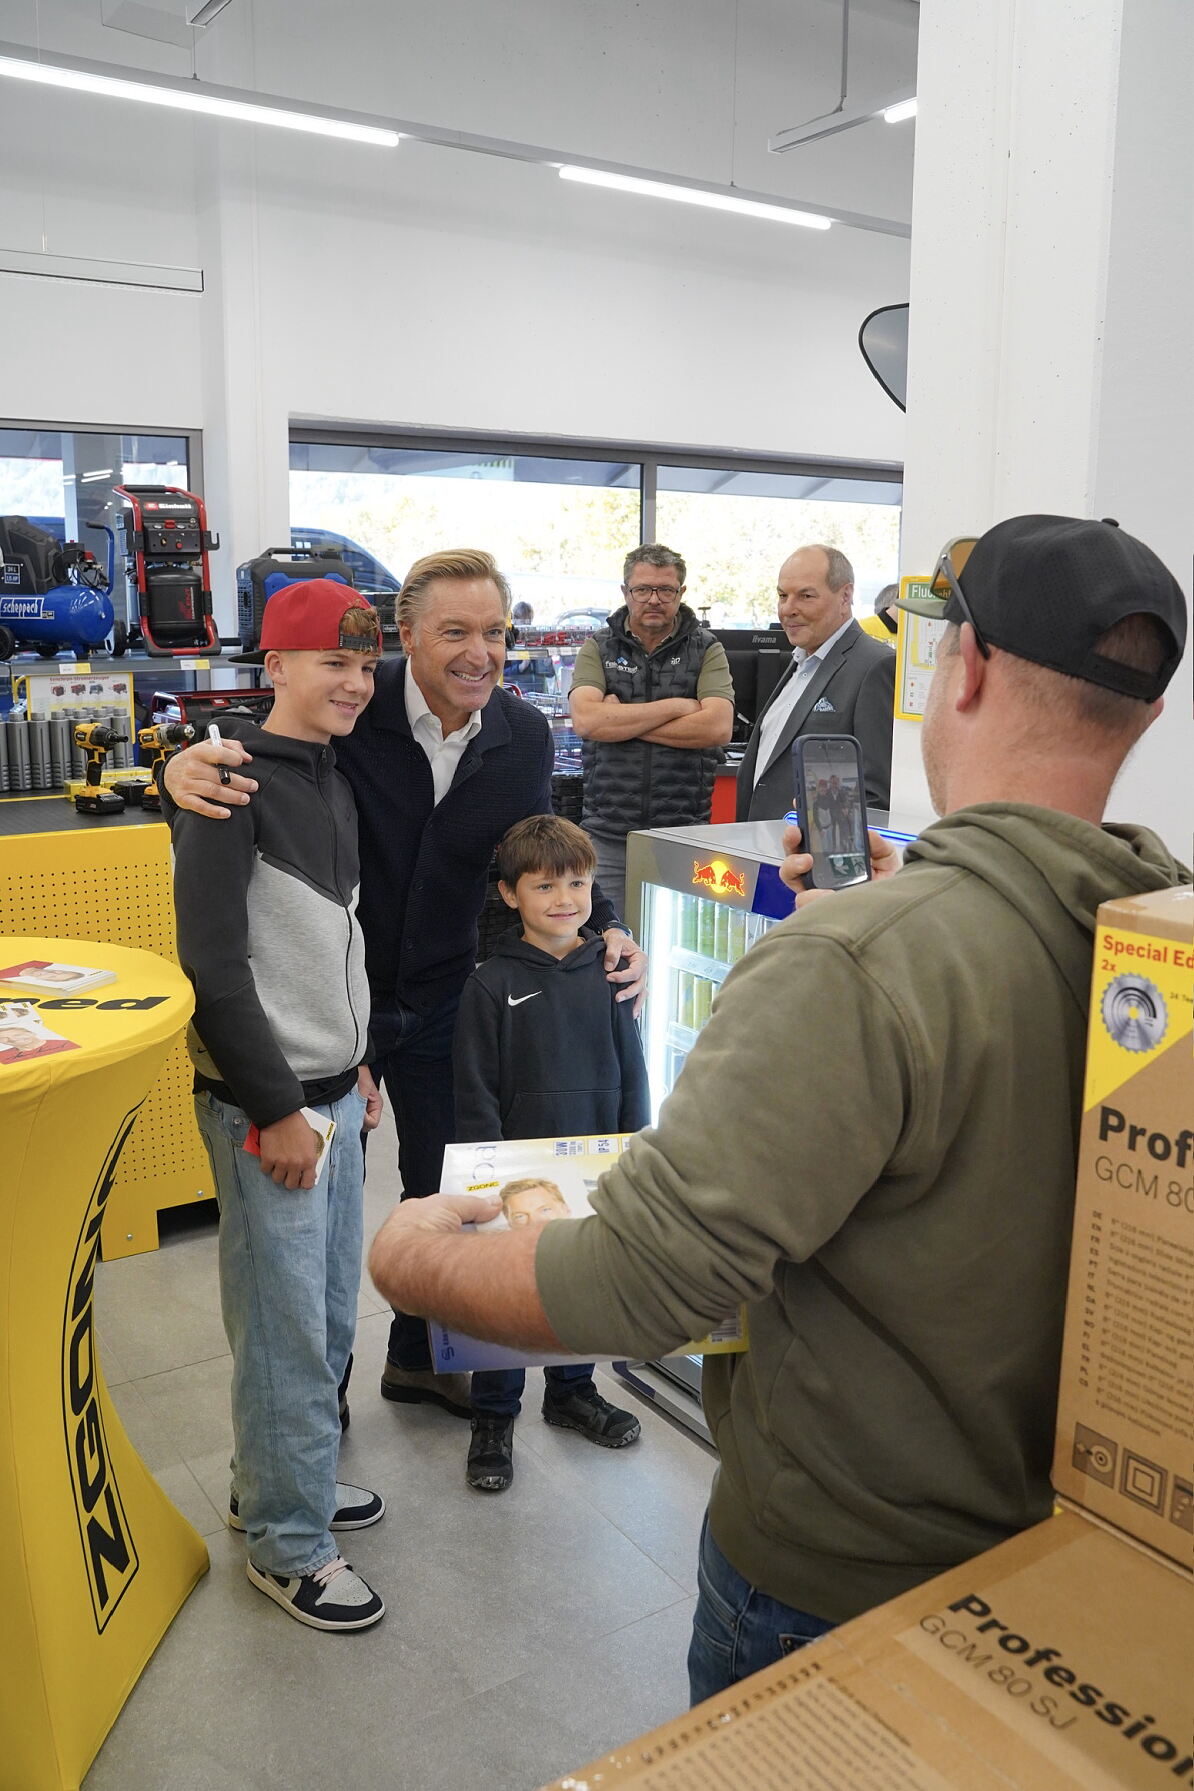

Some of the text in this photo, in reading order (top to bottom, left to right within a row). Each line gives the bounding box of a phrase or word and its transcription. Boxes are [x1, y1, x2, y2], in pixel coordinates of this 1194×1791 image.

[2, 598, 38, 618] scheppach
[1101, 959, 1116, 972] 2x
[1103, 934, 1168, 963] Special
[1099, 1105, 1193, 1168] Prof
[1095, 1155, 1158, 1200] GCM
[70, 1112, 138, 1611] ZGONC
[920, 1614, 1078, 1730] GCM 80 SJ
